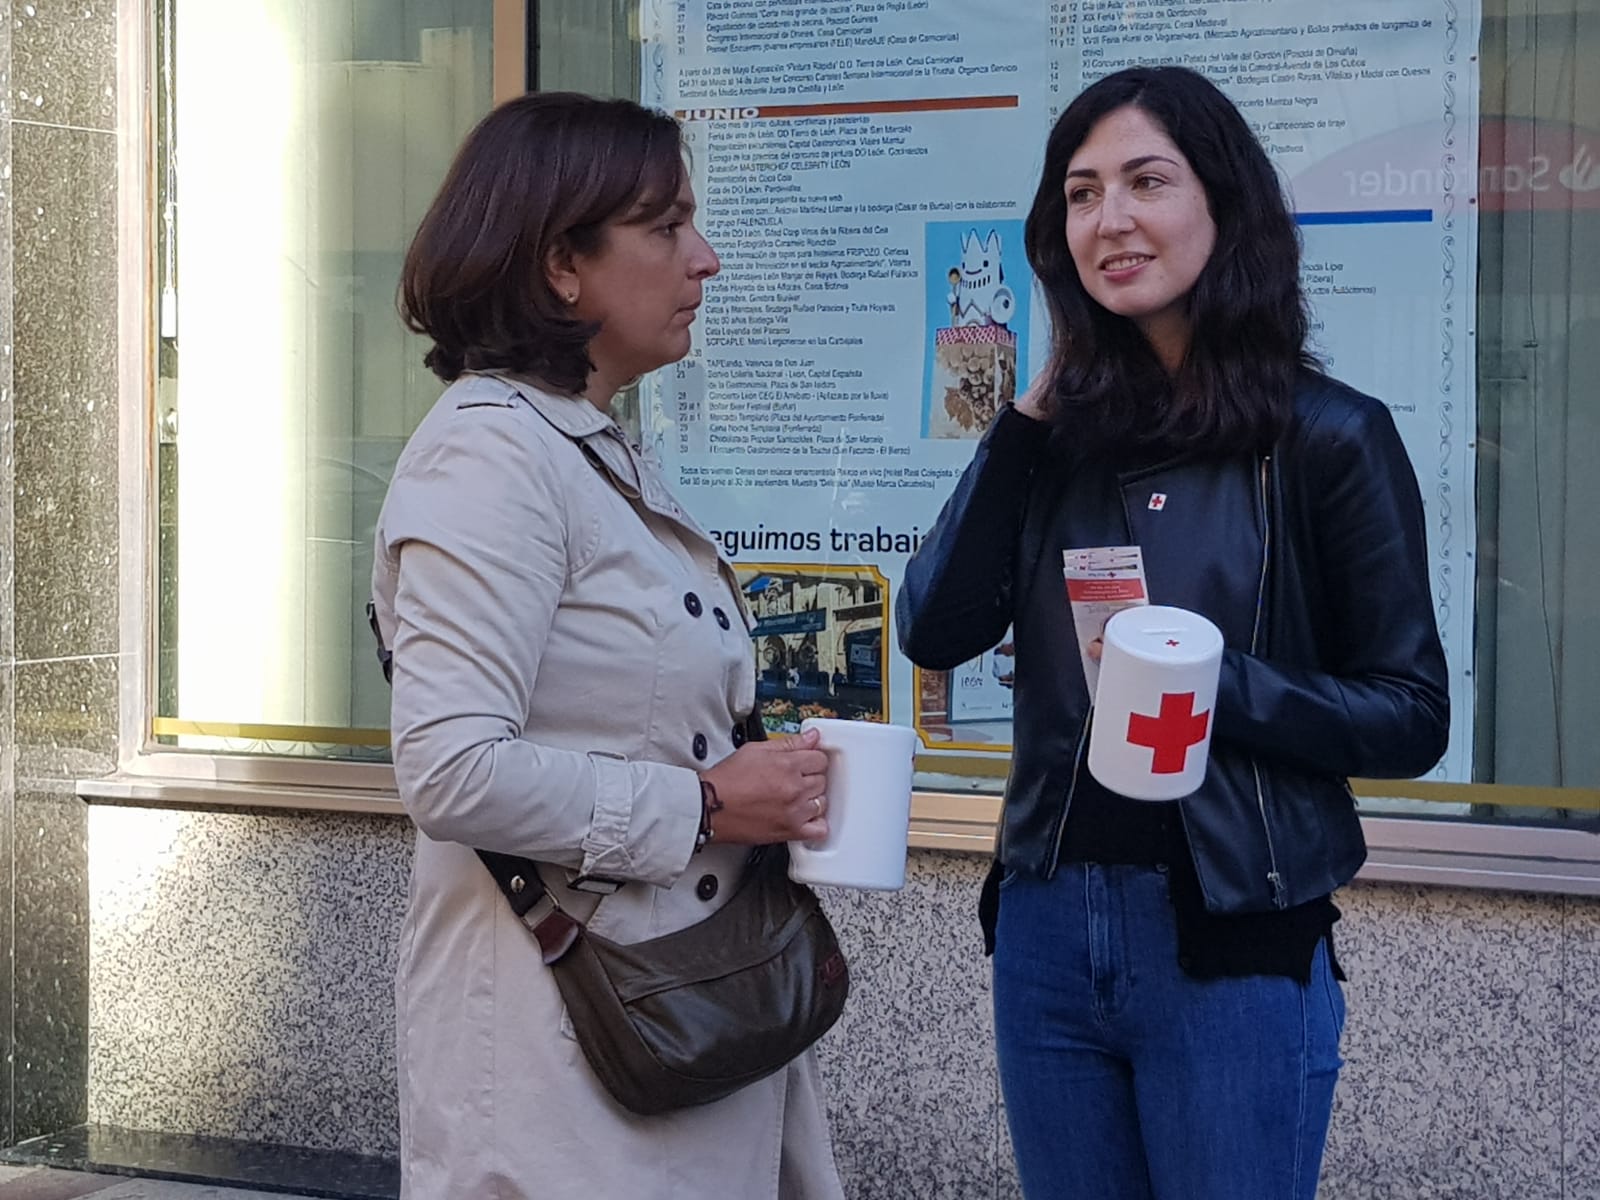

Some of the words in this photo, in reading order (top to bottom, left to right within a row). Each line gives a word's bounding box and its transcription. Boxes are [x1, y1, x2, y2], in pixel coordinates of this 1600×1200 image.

[680, 107, 760, 121] JUNIO
[709, 524, 820, 557] eguimos
[830, 526, 927, 553] trabaj
